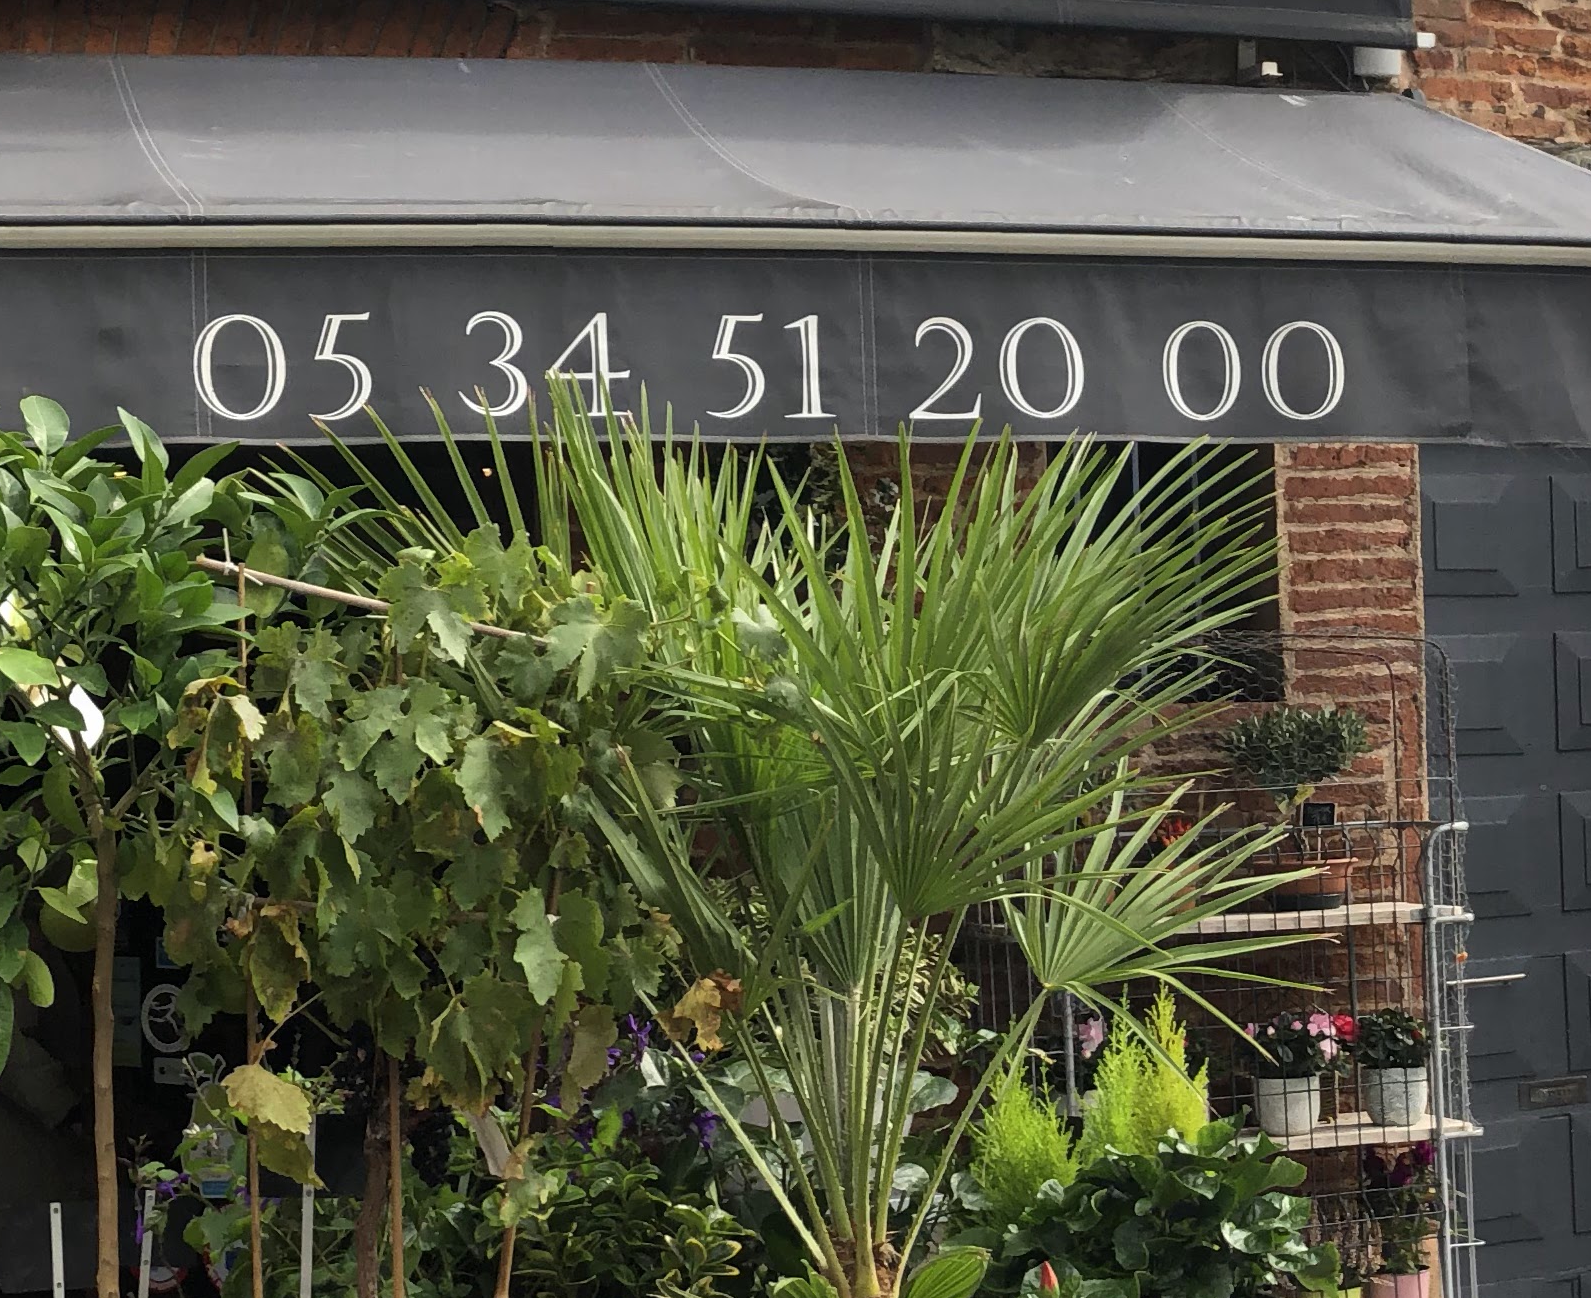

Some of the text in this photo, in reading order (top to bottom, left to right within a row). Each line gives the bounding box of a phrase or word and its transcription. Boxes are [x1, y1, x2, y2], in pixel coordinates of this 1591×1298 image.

[193, 310, 1345, 421] 05 34 51 20 00
